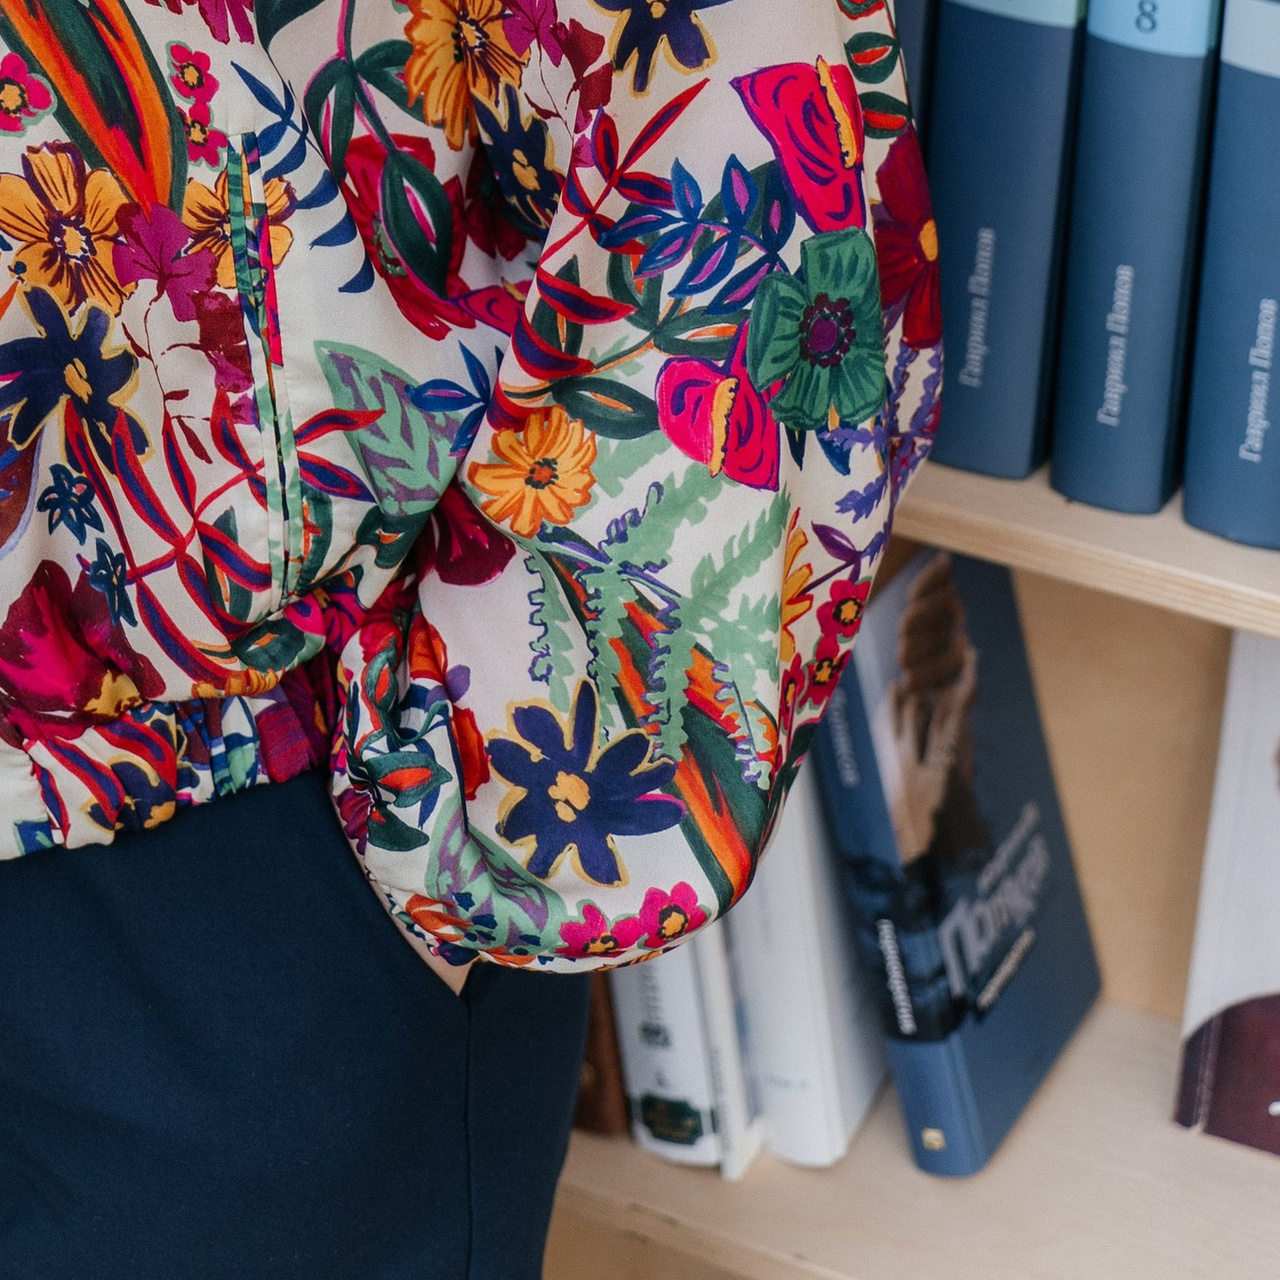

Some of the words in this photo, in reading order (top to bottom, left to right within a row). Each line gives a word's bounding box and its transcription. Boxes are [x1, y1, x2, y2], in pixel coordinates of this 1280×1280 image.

[967, 226, 997, 296] Попов
[1105, 263, 1136, 334] Попов
[1248, 297, 1279, 370] Попов
